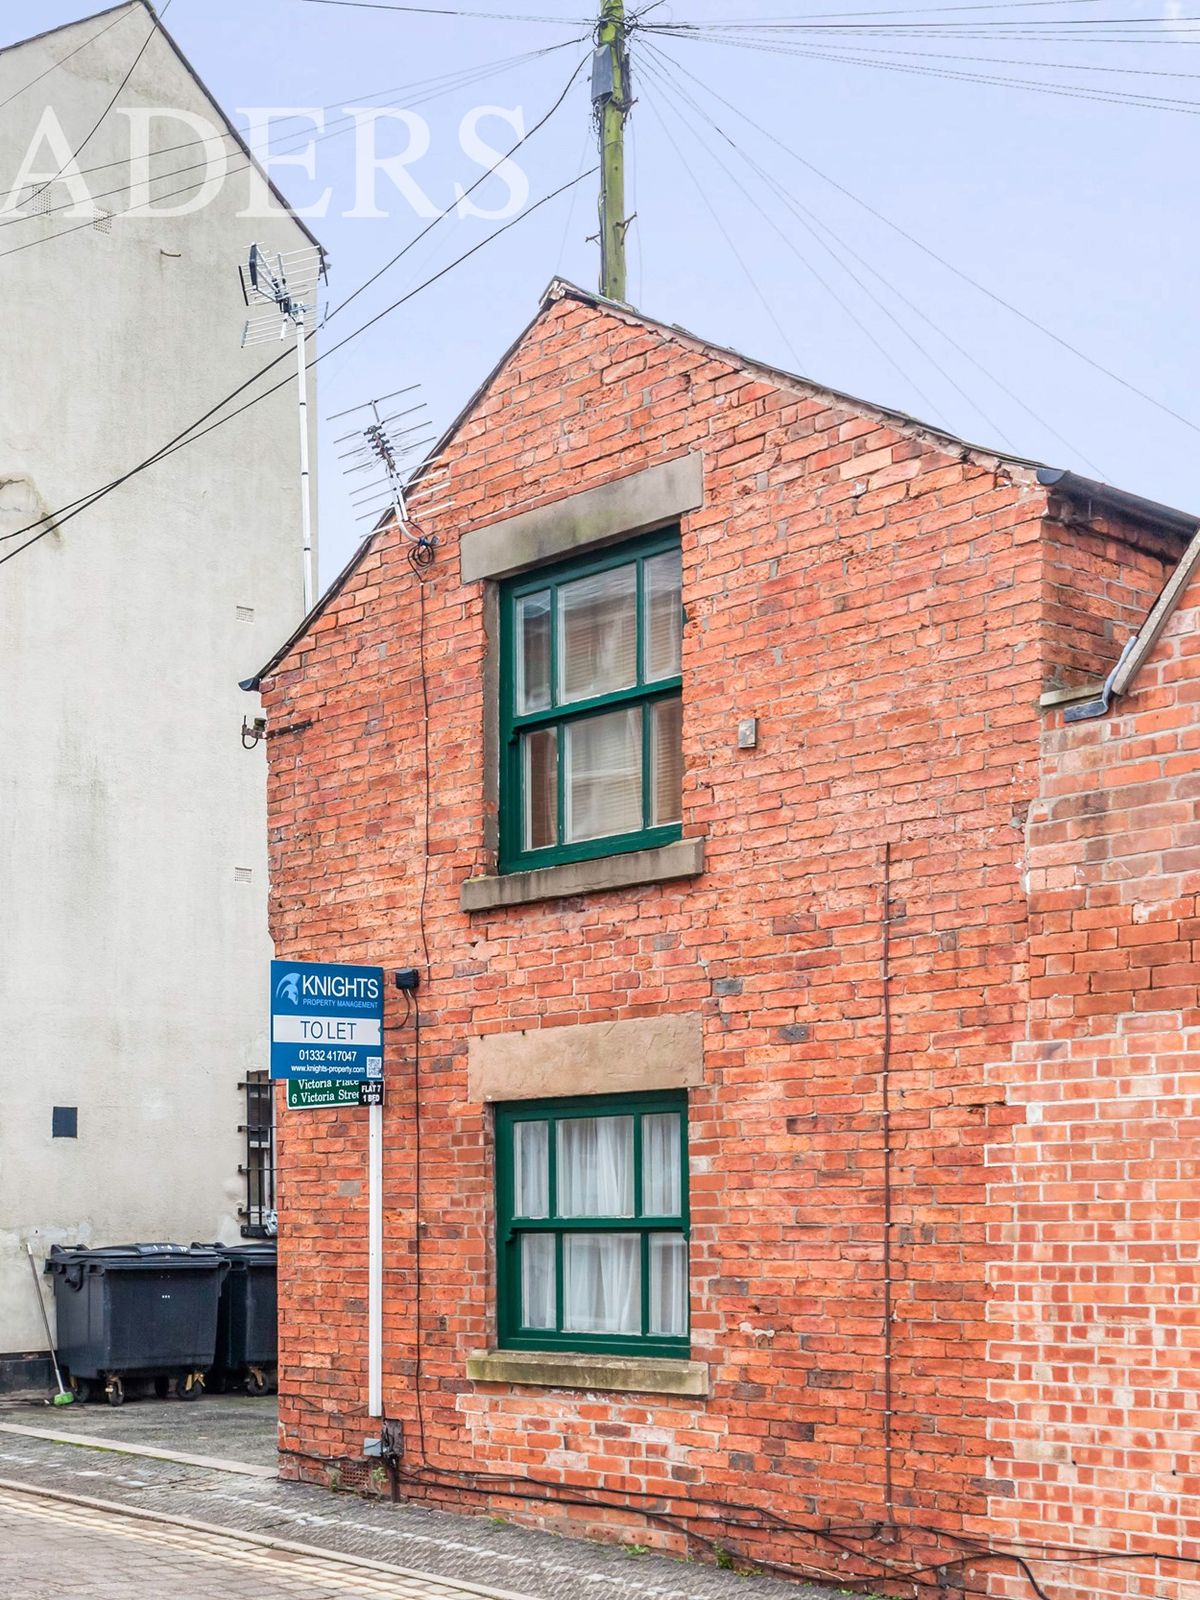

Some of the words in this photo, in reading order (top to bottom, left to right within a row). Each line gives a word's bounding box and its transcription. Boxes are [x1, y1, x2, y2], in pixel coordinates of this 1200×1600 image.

[302, 975, 379, 999] KNIGHTS
[302, 998, 336, 1007] PROPERTY
[337, 1000, 378, 1009] MANAGEMENT
[300, 1020, 324, 1039] TO
[327, 1021, 357, 1040] LET
[299, 1049, 326, 1061] 01332
[326, 1050, 357, 1062] 417047
[290, 1064, 366, 1075] www.knights-property.com
[298, 1079, 332, 1090] Victoria
[361, 1085, 376, 1093] FLAT
[291, 1094, 298, 1104] 6
[301, 1091, 335, 1103] Victoria
[338, 1089, 360, 1101] Stre
